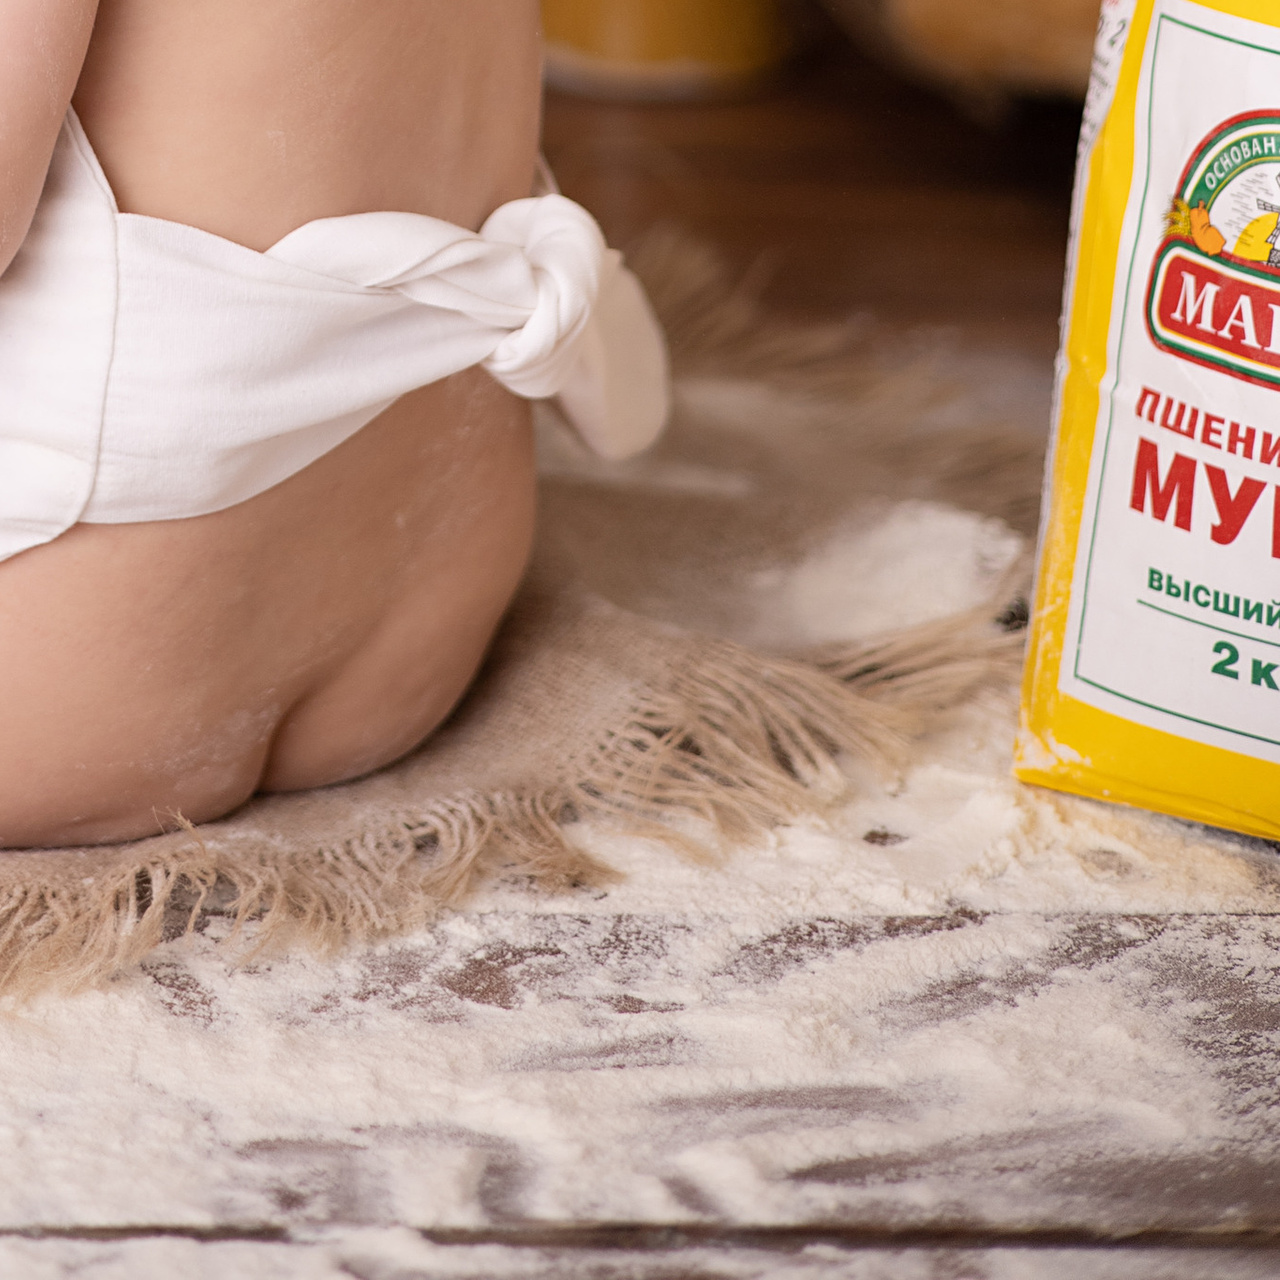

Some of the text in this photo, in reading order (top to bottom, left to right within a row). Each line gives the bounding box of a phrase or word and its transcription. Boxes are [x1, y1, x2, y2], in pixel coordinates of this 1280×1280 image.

[1204, 135, 1280, 190] ОСНОВАН
[1129, 435, 1280, 559] МУ
[1211, 640, 1239, 680] 2
